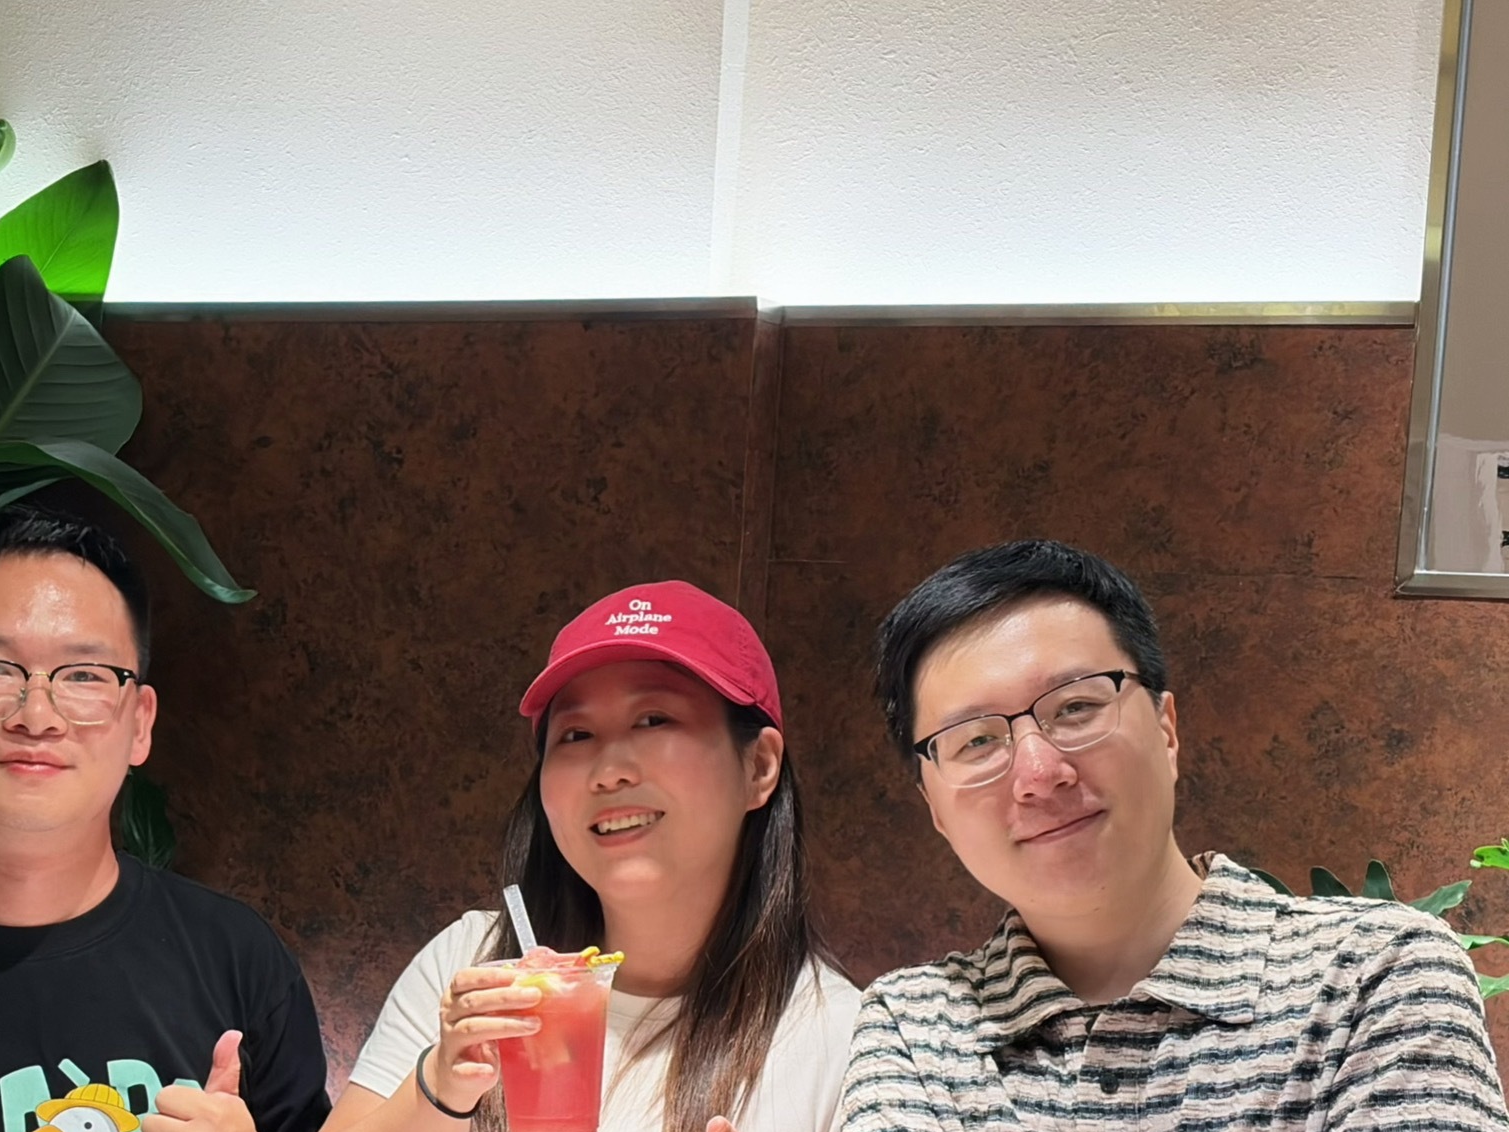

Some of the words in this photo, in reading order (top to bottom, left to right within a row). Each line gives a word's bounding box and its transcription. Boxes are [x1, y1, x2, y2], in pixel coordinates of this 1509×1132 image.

[629, 599, 652, 611] On
[605, 611, 672, 625] Airplane
[614, 624, 659, 635] Mode
